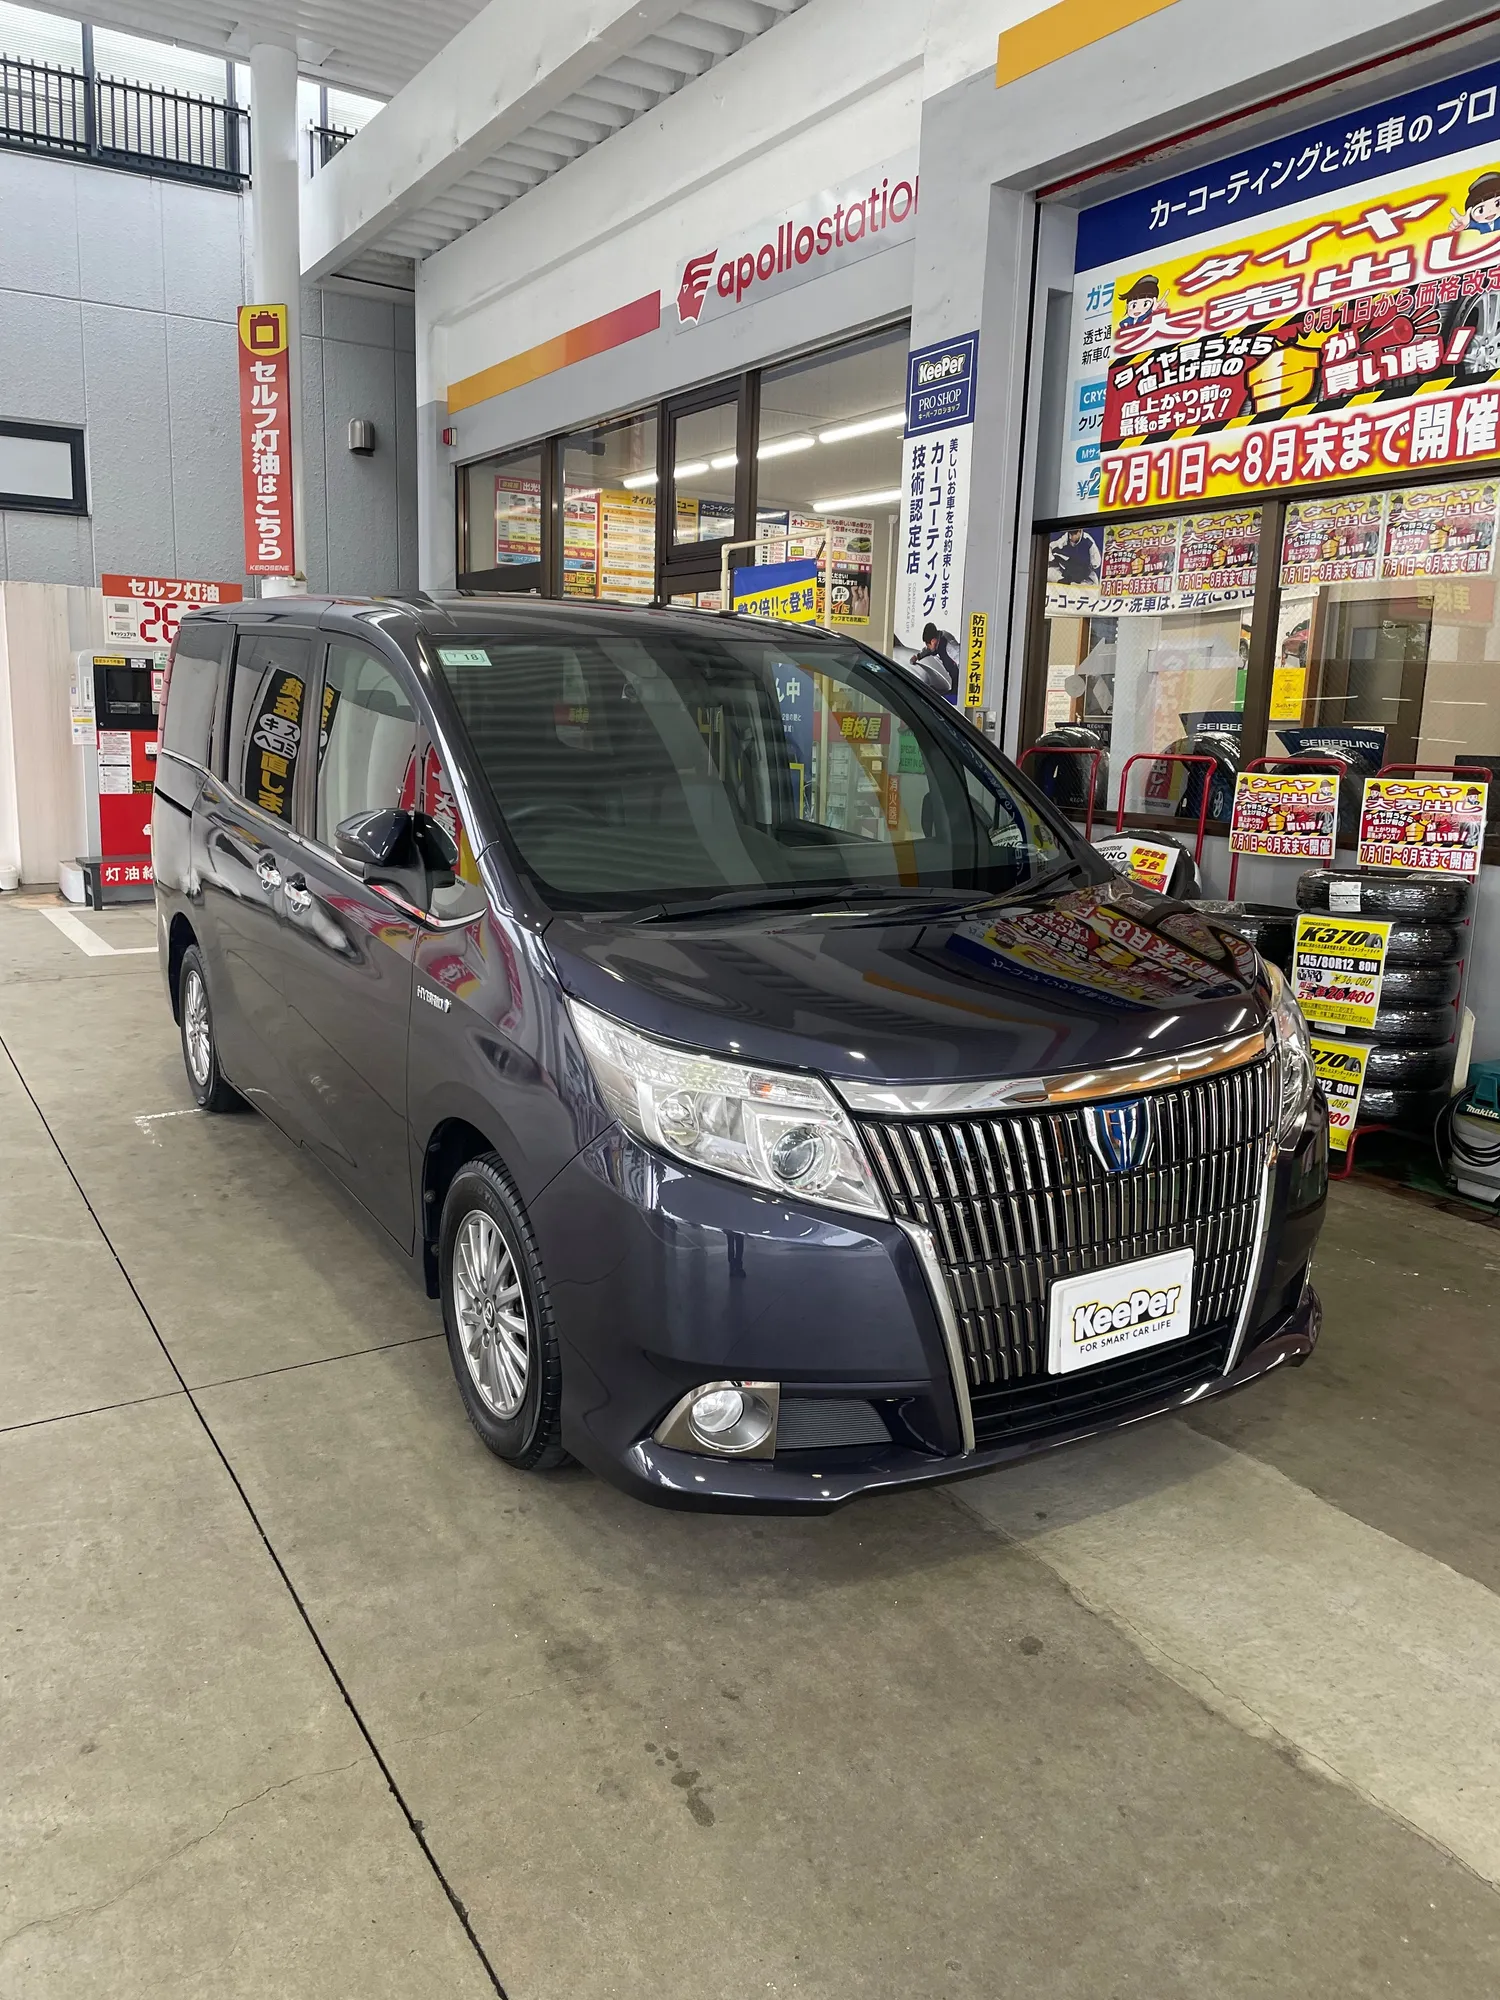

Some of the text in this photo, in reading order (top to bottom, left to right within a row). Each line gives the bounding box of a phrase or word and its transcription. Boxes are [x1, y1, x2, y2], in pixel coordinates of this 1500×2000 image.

[1148, 85, 1498, 231] カーコーティングと洗車のプロ
[1179, 194, 1447, 294] タイヤ
[1117, 233, 1500, 353] 大売出し
[1303, 267, 1500, 333] 9月1日から価格改定
[918, 354, 966, 385] KeePer
[1113, 334, 1274, 388] タイヤ買うなら
[1323, 327, 1473, 397] 買い時!
[1137, 357, 1244, 397] 値上げ前の
[917, 403, 961, 420] キーパープロショップ
[918, 388, 962, 412] PRO SHOP
[1120, 384, 1232, 419] 値上がり前の
[1119, 399, 1230, 438] 最後のチャンス!
[249, 361, 283, 561] セルフ灯油はこちら
[1408, 489, 1479, 506] タイヤ
[906, 444, 927, 575] 技術認定店
[1197, 514, 1250, 528] タイヤ
[1304, 501, 1366, 518] タイヤ
[1389, 501, 1496, 521] 大売出し
[922, 442, 944, 617] カーコーティング
[941, 438, 959, 617] 美しいお車をお約束します。
[1118, 525, 1165, 538] タイヤ
[1182, 525, 1261, 543] 大売出し
[1287, 513, 1381, 533] 大売出し
[1105, 536, 1176, 551] 大売出し
[249, 564, 290, 572] KEROSENE
[128, 578, 220, 603] セルフ灯油
[968, 614, 985, 706] 防犯カメラ作動中
[840, 716, 881, 739] 車検屋
[256, 733, 296, 759] ヘコミ
[1300, 739, 1380, 750] SEIBERLING
[1252, 778, 1316, 791] タイヤ
[1385, 784, 1462, 798] タイヤ
[1237, 790, 1336, 805] 大売出し
[1366, 797, 1483, 813] 大売出し
[1231, 834, 1332, 856] 7月1日～8月末まで開催
[1136, 859, 1160, 871] 5台
[1360, 844, 1477, 871] 7月1日～8月末まで開催
[1300, 927, 1371, 946] K370
[1299, 954, 1378, 973] 145/80R12 80N
[417, 985, 443, 1011] HYBRID
[1310, 1048, 1350, 1069] 370
[1336, 1083, 1356, 1096] 80N
[1072, 1284, 1182, 1343] KeePer
[1080, 1319, 1172, 1354] FOR SMART CAR LIFE
